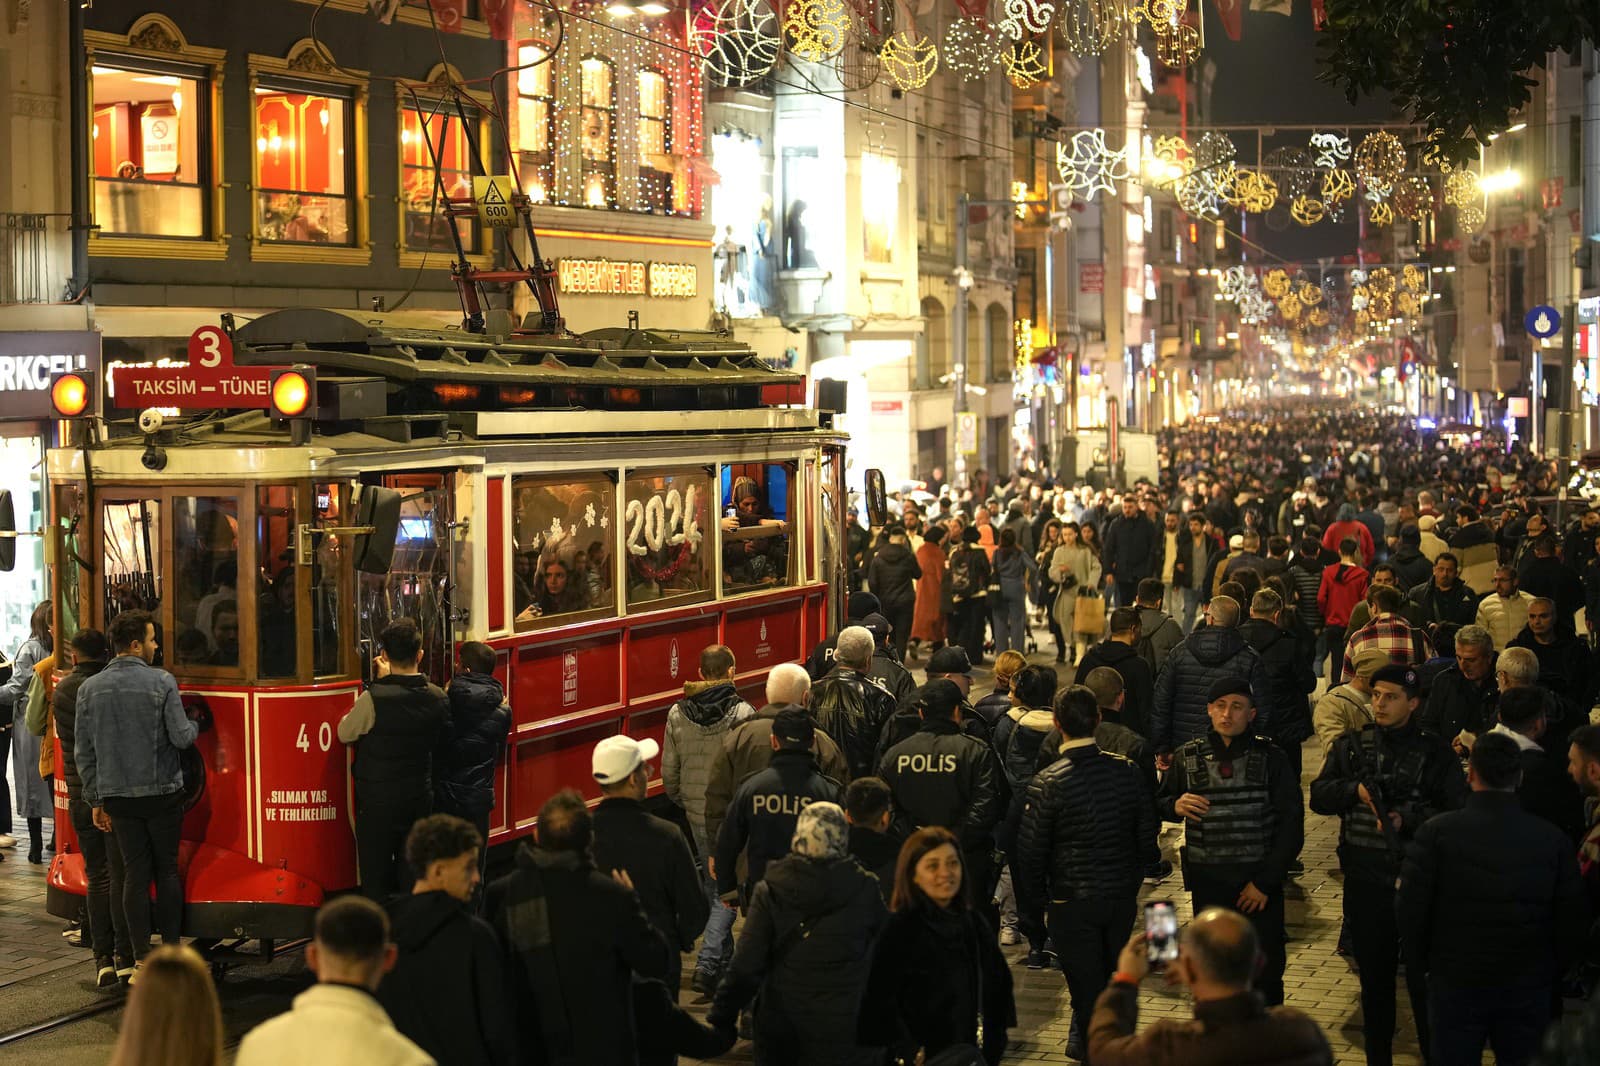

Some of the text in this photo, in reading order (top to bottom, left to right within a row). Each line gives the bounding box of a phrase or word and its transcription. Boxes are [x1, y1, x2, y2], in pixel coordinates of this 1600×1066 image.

[486, 206, 508, 217] 600
[198, 331, 221, 368] 3
[133, 376, 196, 395] TAKSİM
[626, 484, 703, 557] 2024
[265, 805, 337, 822] VE TEHLİKELİDİR
